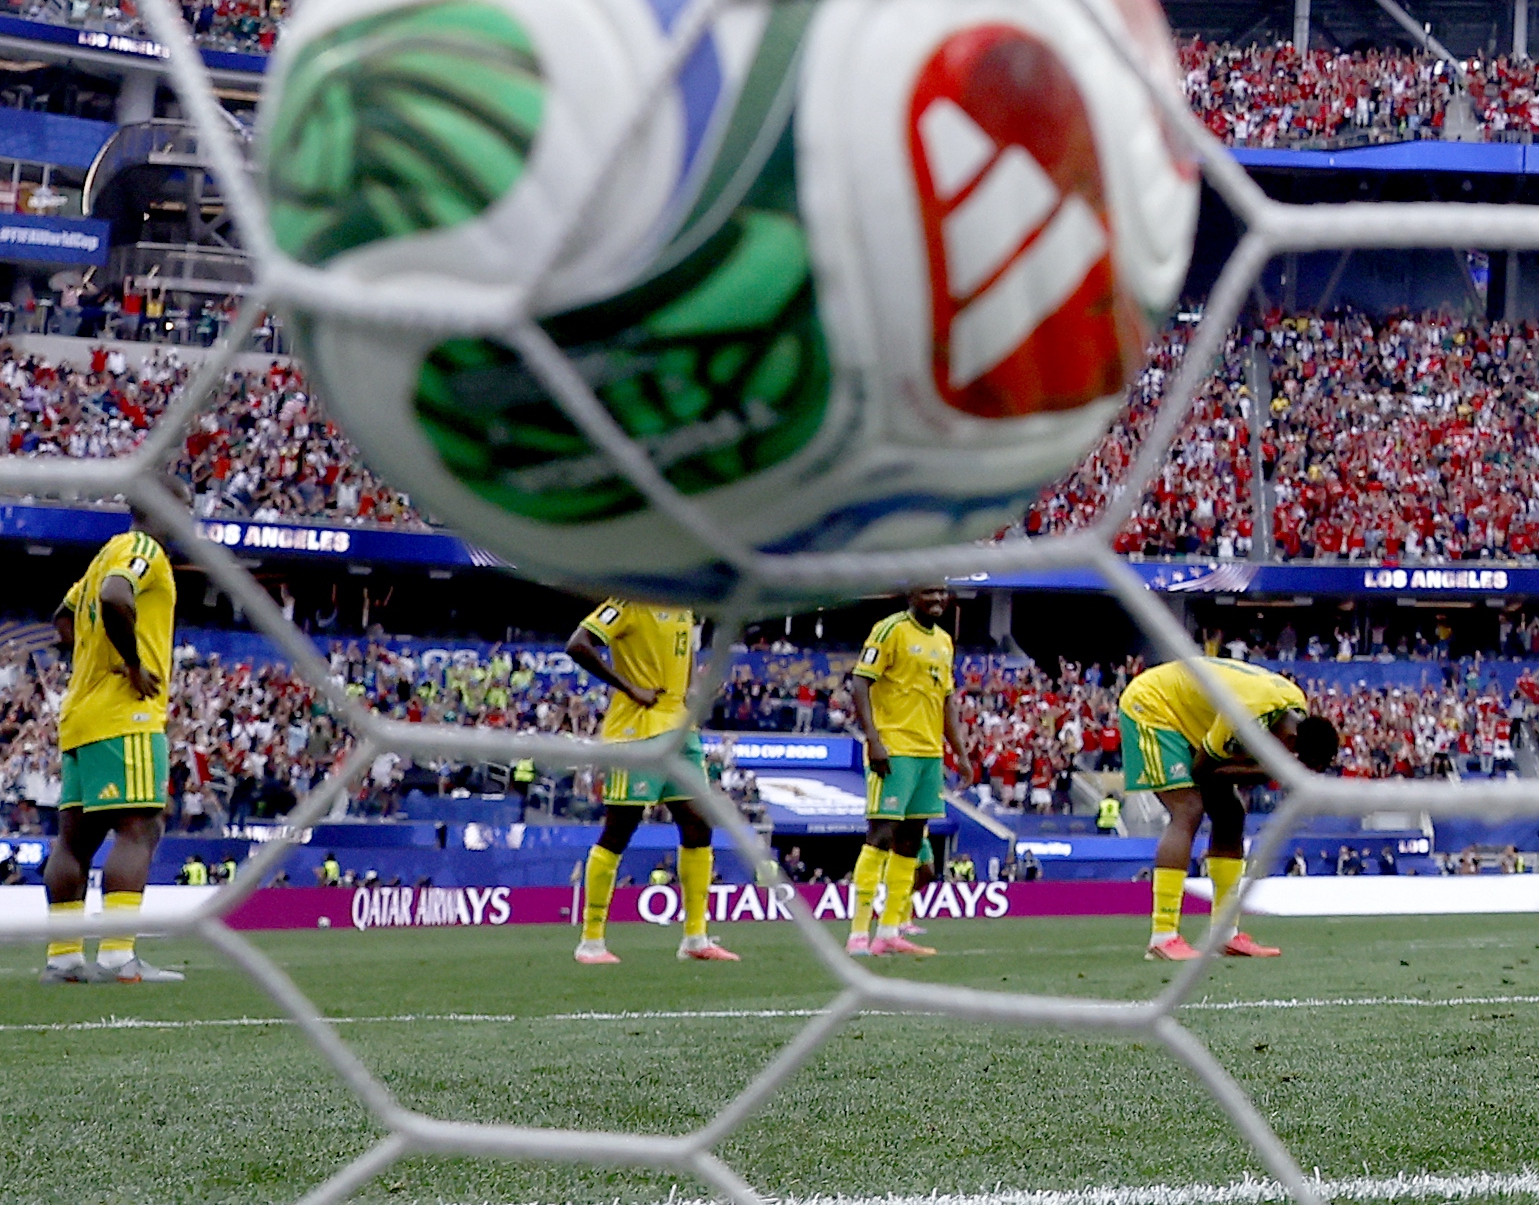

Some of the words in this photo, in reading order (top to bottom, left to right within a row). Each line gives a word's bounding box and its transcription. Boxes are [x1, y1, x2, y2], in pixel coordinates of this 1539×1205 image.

[243, 526, 350, 553] ANGELES
[1364, 570, 1407, 589] LOS
[1410, 570, 1509, 589] ANGELES
[352, 887, 414, 927] QATAR
[638, 883, 795, 925] QTAR
